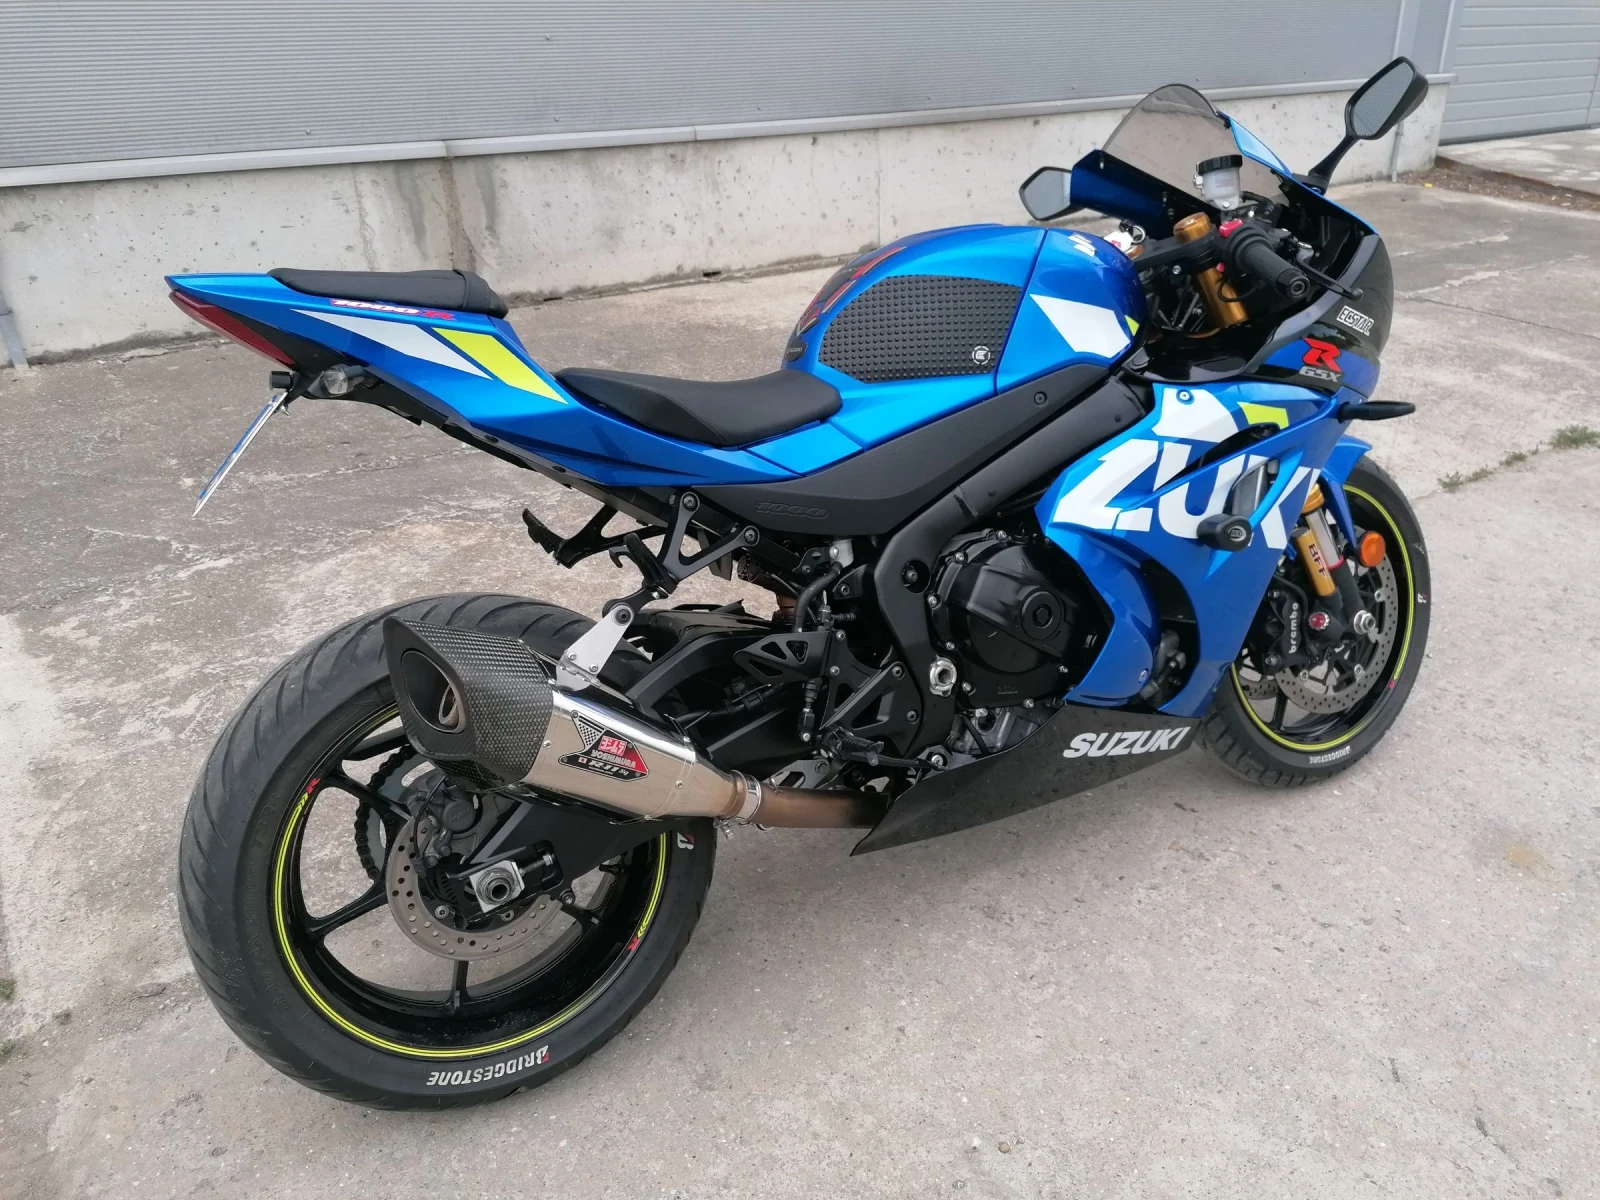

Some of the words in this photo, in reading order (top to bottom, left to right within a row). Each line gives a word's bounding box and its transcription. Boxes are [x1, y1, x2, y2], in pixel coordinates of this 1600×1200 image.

[1302, 337, 1343, 373] R
[1299, 366, 1342, 382] GSX
[1053, 438, 1321, 550] ZUK
[756, 502, 830, 519] 1000
[1289, 602, 1299, 654] brembo
[1063, 726, 1191, 758] SUZUKI
[1309, 745, 1352, 764] BRIDGESTONE
[590, 749, 637, 768] YOSHIMURA
[426, 1045, 550, 1086] BRIDGESTONE
